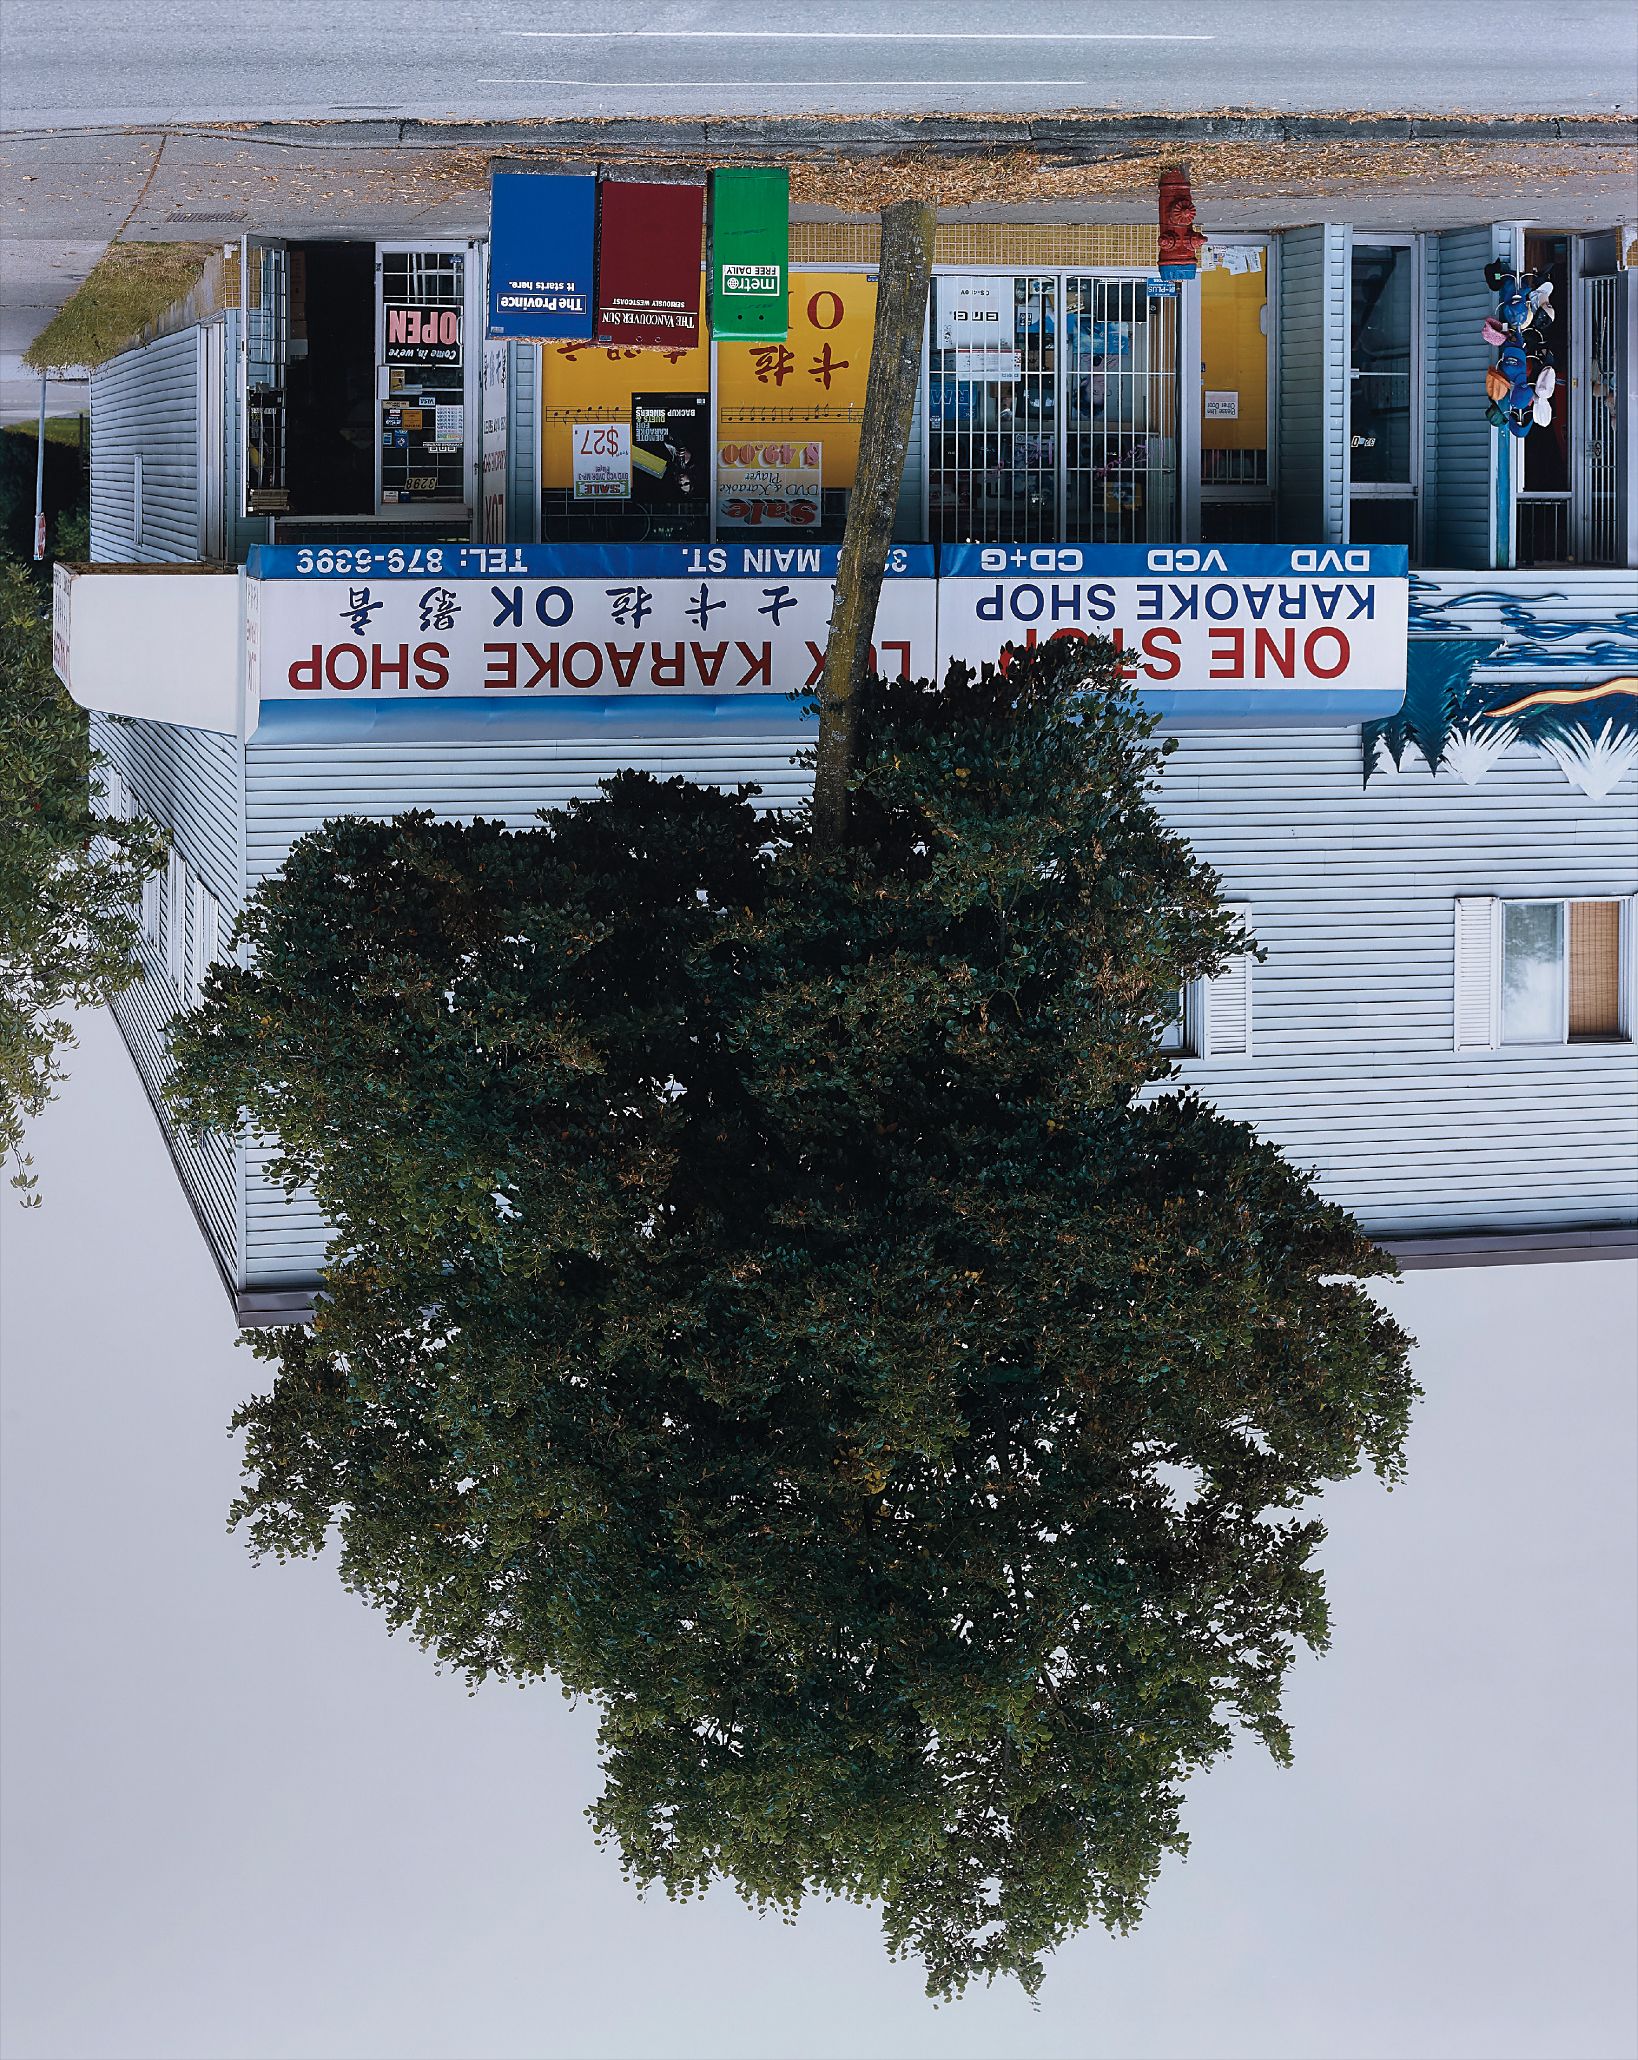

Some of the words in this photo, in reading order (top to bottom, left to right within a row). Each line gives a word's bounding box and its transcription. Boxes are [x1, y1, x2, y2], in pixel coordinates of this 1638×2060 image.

[726, 266, 752, 275] DAILY
[754, 266, 777, 275] FREE
[508, 281, 533, 291] here.
[535, 281, 564, 291] starts
[566, 282, 575, 291] It
[726, 277, 775, 292] metro
[500, 296, 557, 311] Province
[559, 297, 583, 311] The
[612, 298, 650, 306] WESTCOAST
[651, 300, 685, 308] SERIOUSLY
[601, 312, 621, 325] SUN
[622, 312, 675, 327] VANCOUVER
[675, 315, 694, 329] THE
[388, 310, 457, 345] OPEN
[388, 348, 414, 359] we're
[416, 348, 429, 360] in,
[430, 349, 457, 360] Come
[749, 342, 849, 391] 卡拉
[420, 398, 435, 406] VISA
[635, 409, 666, 417] SINGERS
[667, 409, 695, 417] BACKUP
[1218, 408, 1236, 416] Please
[636, 434, 664, 442] REMOTE
[744, 470, 781, 483] Player
[406, 478, 436, 489] 3298
[584, 484, 620, 494] SALE
[785, 484, 818, 496] DVD
[719, 484, 773, 497] Karaoke
[721, 499, 817, 525] Sale
[296, 548, 443, 574] 879-6399
[460, 548, 528, 573] TEL:
[682, 548, 727, 573] ST.
[743, 548, 820, 573] MAIN
[980, 548, 1083, 572] CD+G
[1147, 549, 1228, 572] VCD
[1290, 549, 1370, 572] DVD
[975, 583, 1116, 622] SHOP
[1136, 583, 1375, 621] KARAOKE
[1208, 626, 1350, 679] ONE
[288, 642, 450, 690] SHOP
[483, 640, 772, 688] KARAOKE
